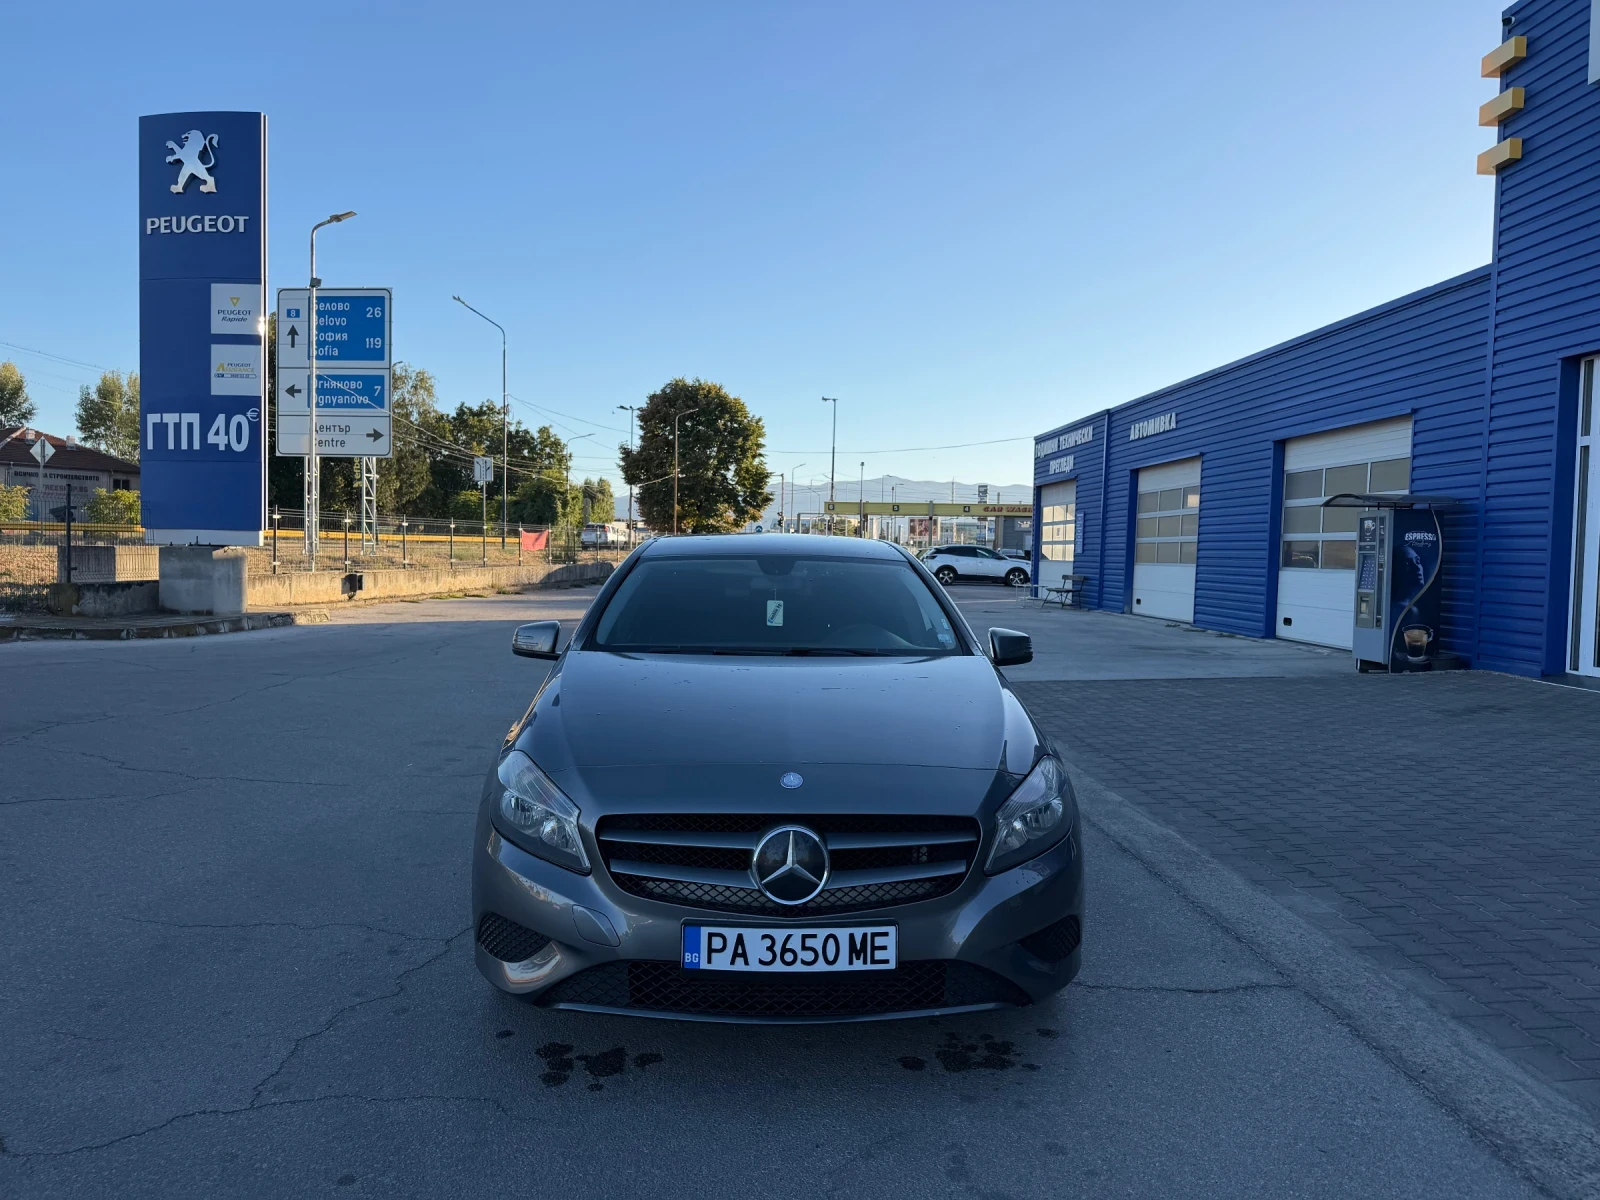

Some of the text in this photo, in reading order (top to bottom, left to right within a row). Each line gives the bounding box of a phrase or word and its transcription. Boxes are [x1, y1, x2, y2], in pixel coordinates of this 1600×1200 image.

[146, 215, 249, 235] PEUGEOT
[290, 309, 296, 318] 8
[366, 306, 382, 318] 26
[366, 337, 382, 348] 119
[373, 386, 382, 397] 7
[146, 412, 200, 450] ГТП
[1129, 411, 1177, 441] АВТОМИВКА
[315, 437, 346, 448] entre
[684, 931, 890, 967] BG PA 3650 ME
